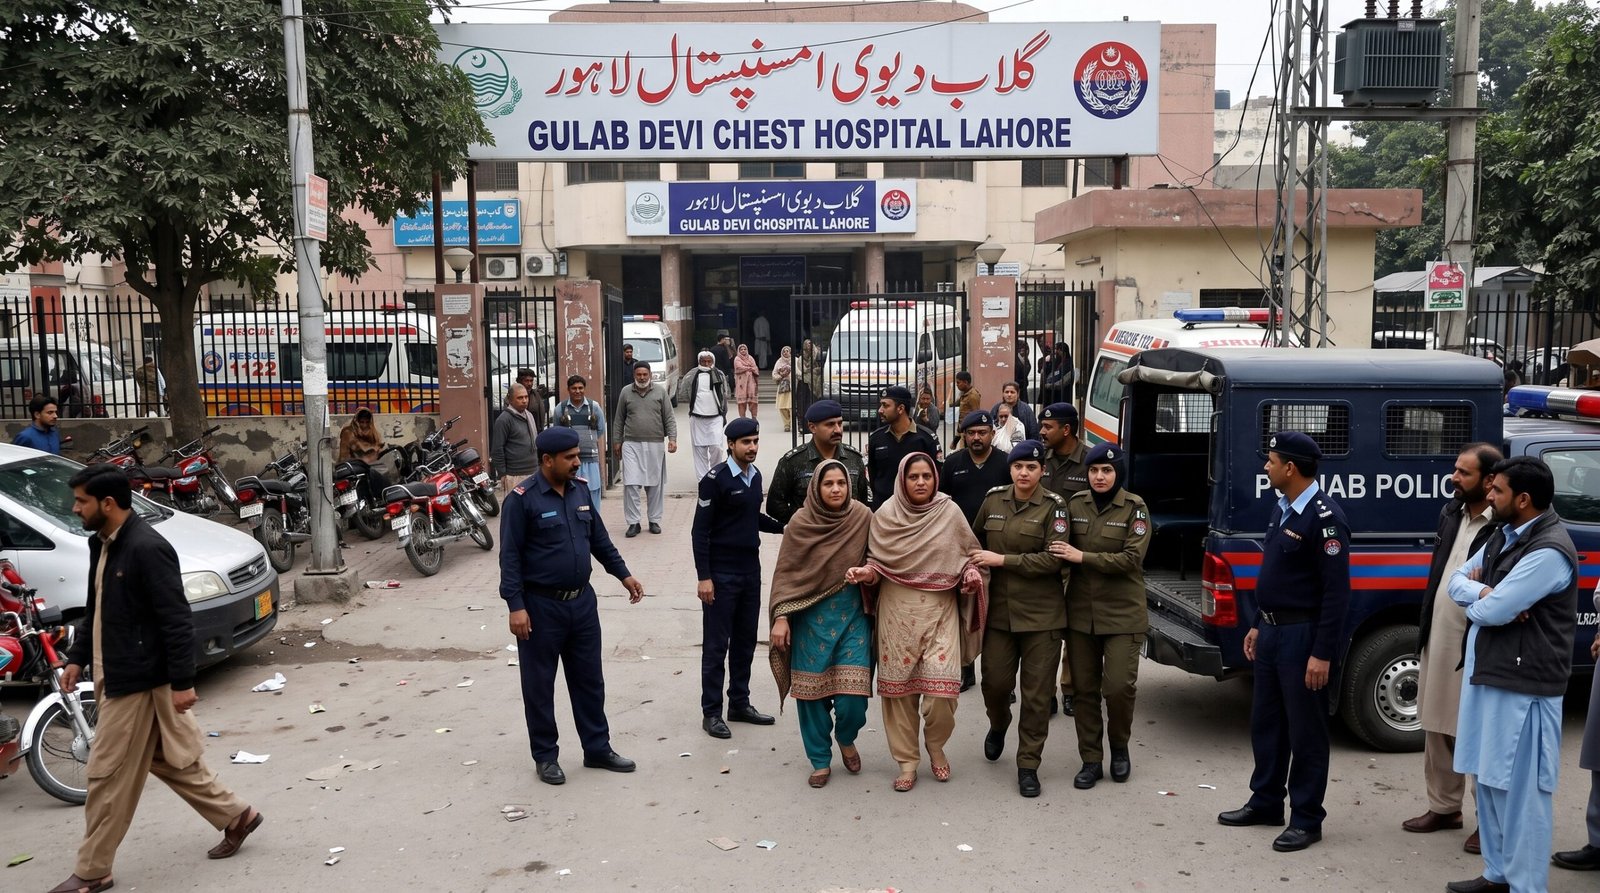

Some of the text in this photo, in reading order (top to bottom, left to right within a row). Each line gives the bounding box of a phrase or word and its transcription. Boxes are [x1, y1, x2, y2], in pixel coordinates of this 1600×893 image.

[547, 51, 631, 95] لاہور
[832, 44, 926, 107] دیوی
[931, 31, 1050, 110] گلاب
[528, 117, 1071, 151] GULAB DEVI CHEST HOSPITAL LAHORE
[684, 192, 720, 211] لاہور
[787, 189, 822, 214] دیوی
[822, 184, 865, 216] گلاب
[680, 217, 870, 231] GULAB DEVI CHOSPITAL LAHORE
[229, 352, 276, 360] RESCUE
[230, 361, 277, 376] 1122
[1255, 473, 1456, 499] PJAB POLIC
